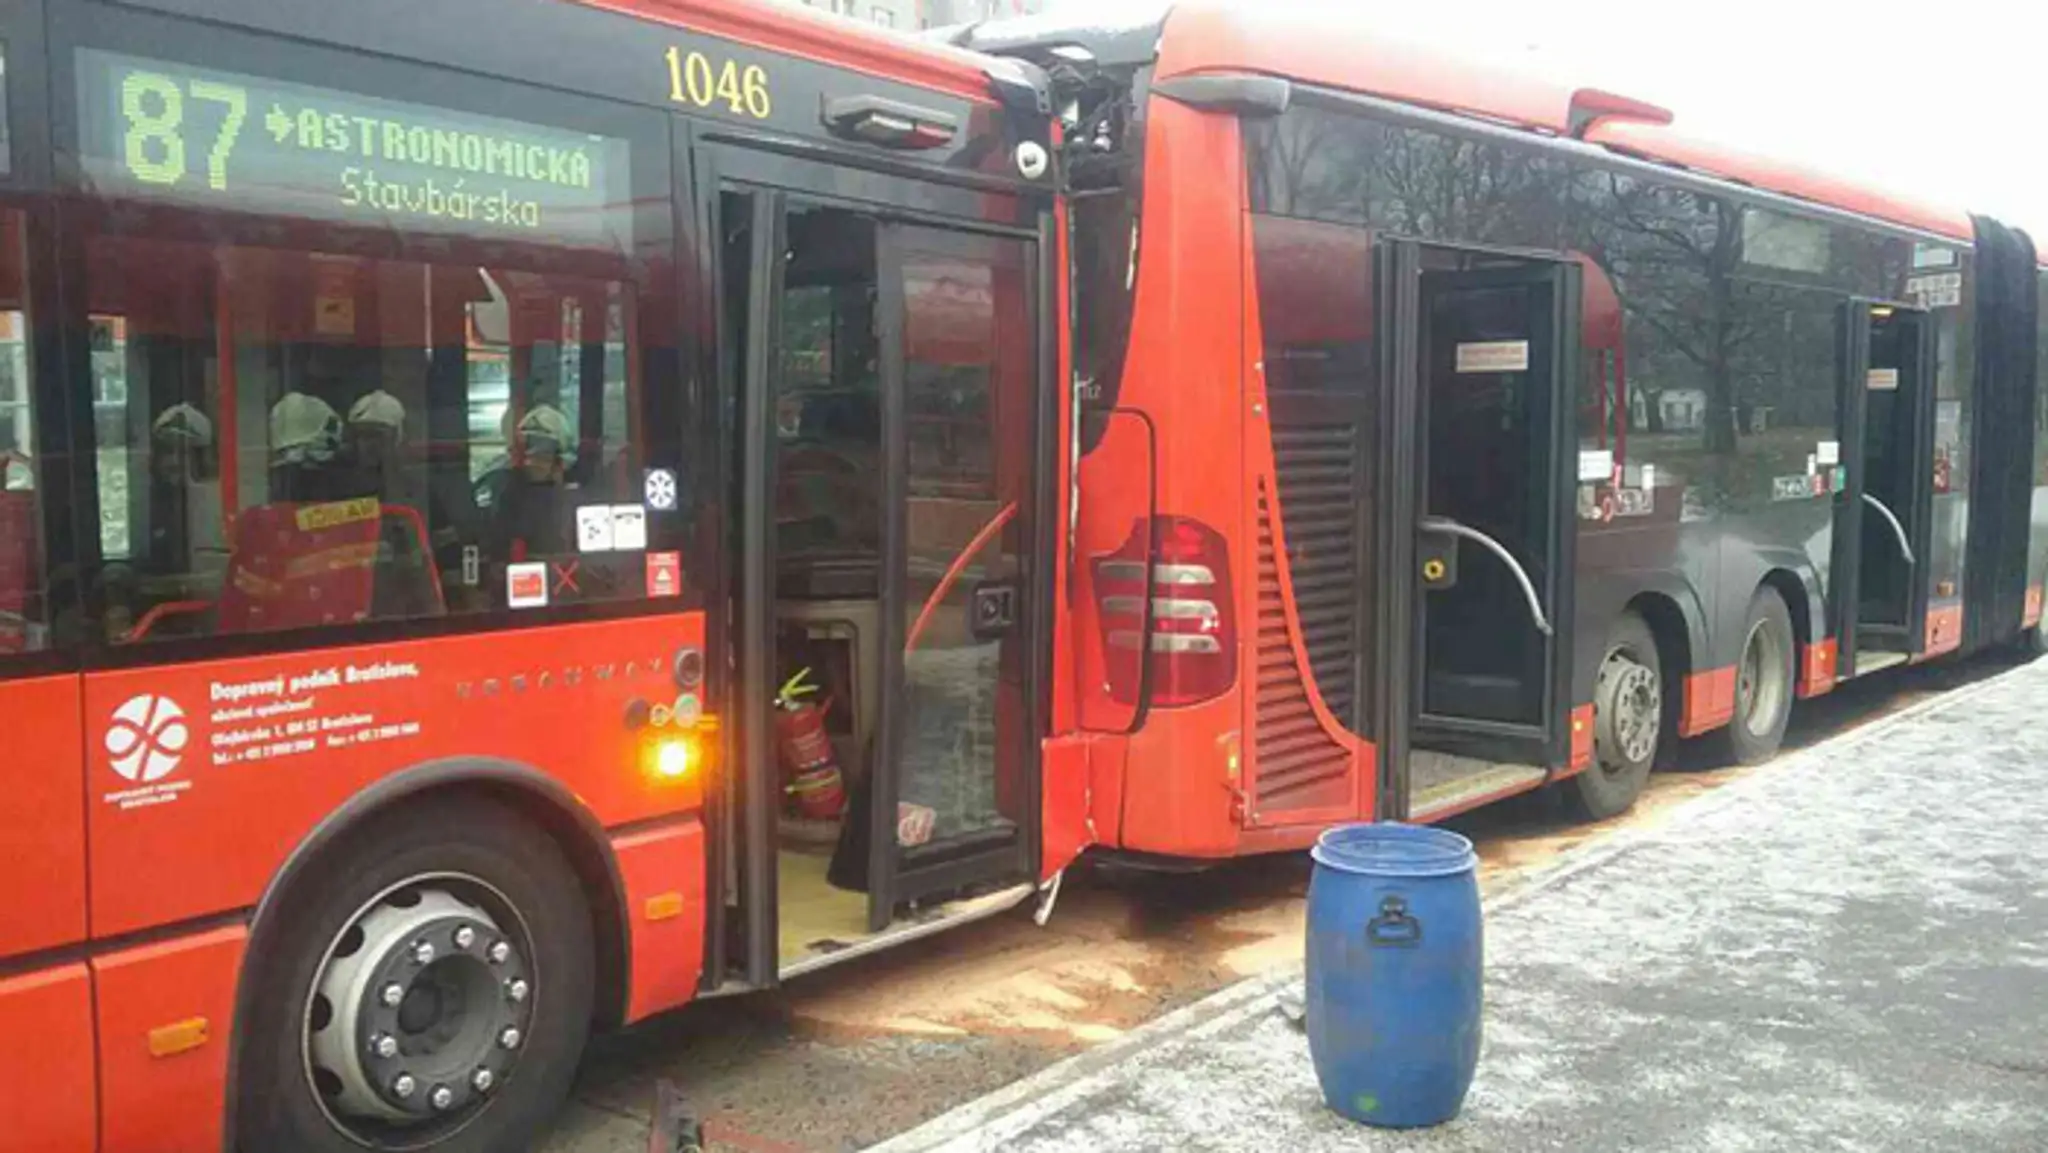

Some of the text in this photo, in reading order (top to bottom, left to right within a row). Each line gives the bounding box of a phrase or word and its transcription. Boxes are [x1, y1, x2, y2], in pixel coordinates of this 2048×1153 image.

[665, 46, 770, 118] 1046
[122, 70, 247, 191] 87
[296, 107, 592, 188] ASTRONOMICKÁ
[340, 166, 540, 227] Stavbárska
[289, 667, 341, 694] podnik
